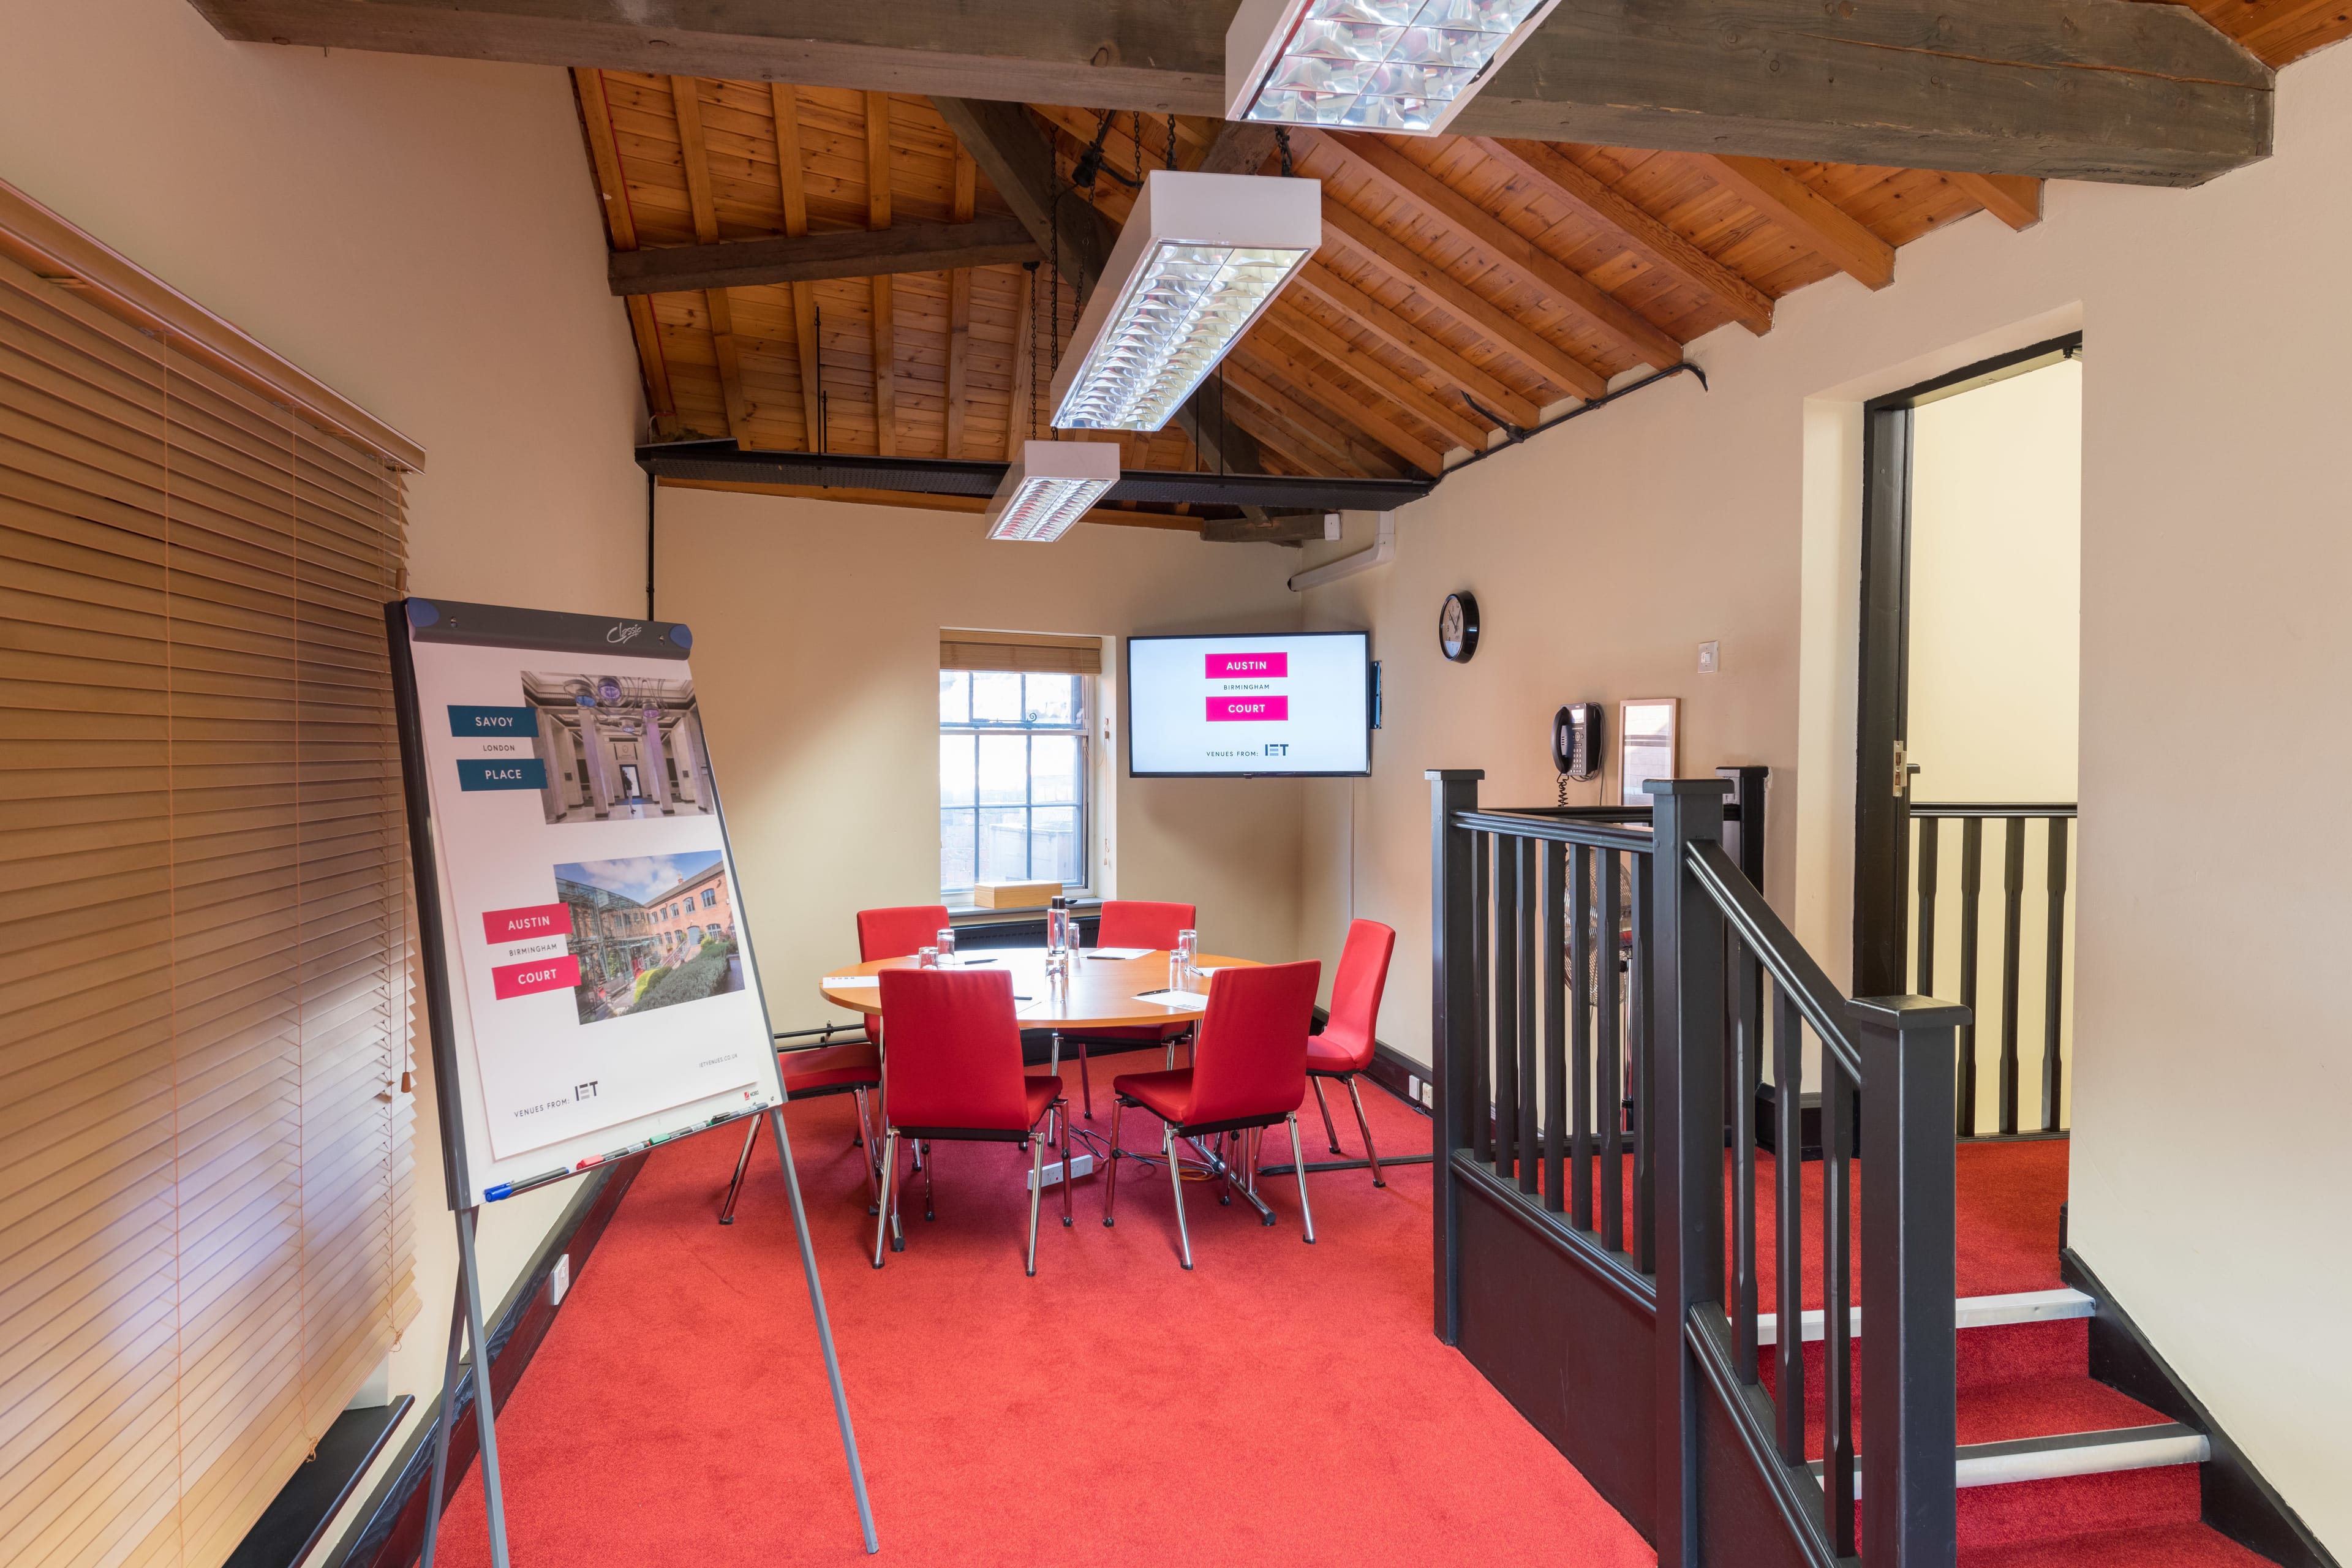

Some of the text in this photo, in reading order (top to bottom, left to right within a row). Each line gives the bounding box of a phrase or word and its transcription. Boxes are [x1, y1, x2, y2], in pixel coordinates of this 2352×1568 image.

[606, 622, 642, 644] Classic
[1226, 661, 1267, 671] AUSTIN
[1227, 704, 1266, 714] COURT
[475, 716, 514, 728] SAVOY
[1265, 744, 1289, 756] IET
[484, 769, 522, 780] PLACE
[508, 915, 550, 931] AUSTIN
[509, 943, 557, 957] BIRMINGHAM
[518, 968, 557, 985] COURT
[514, 1080, 598, 1118] VENUES FROM: IET
